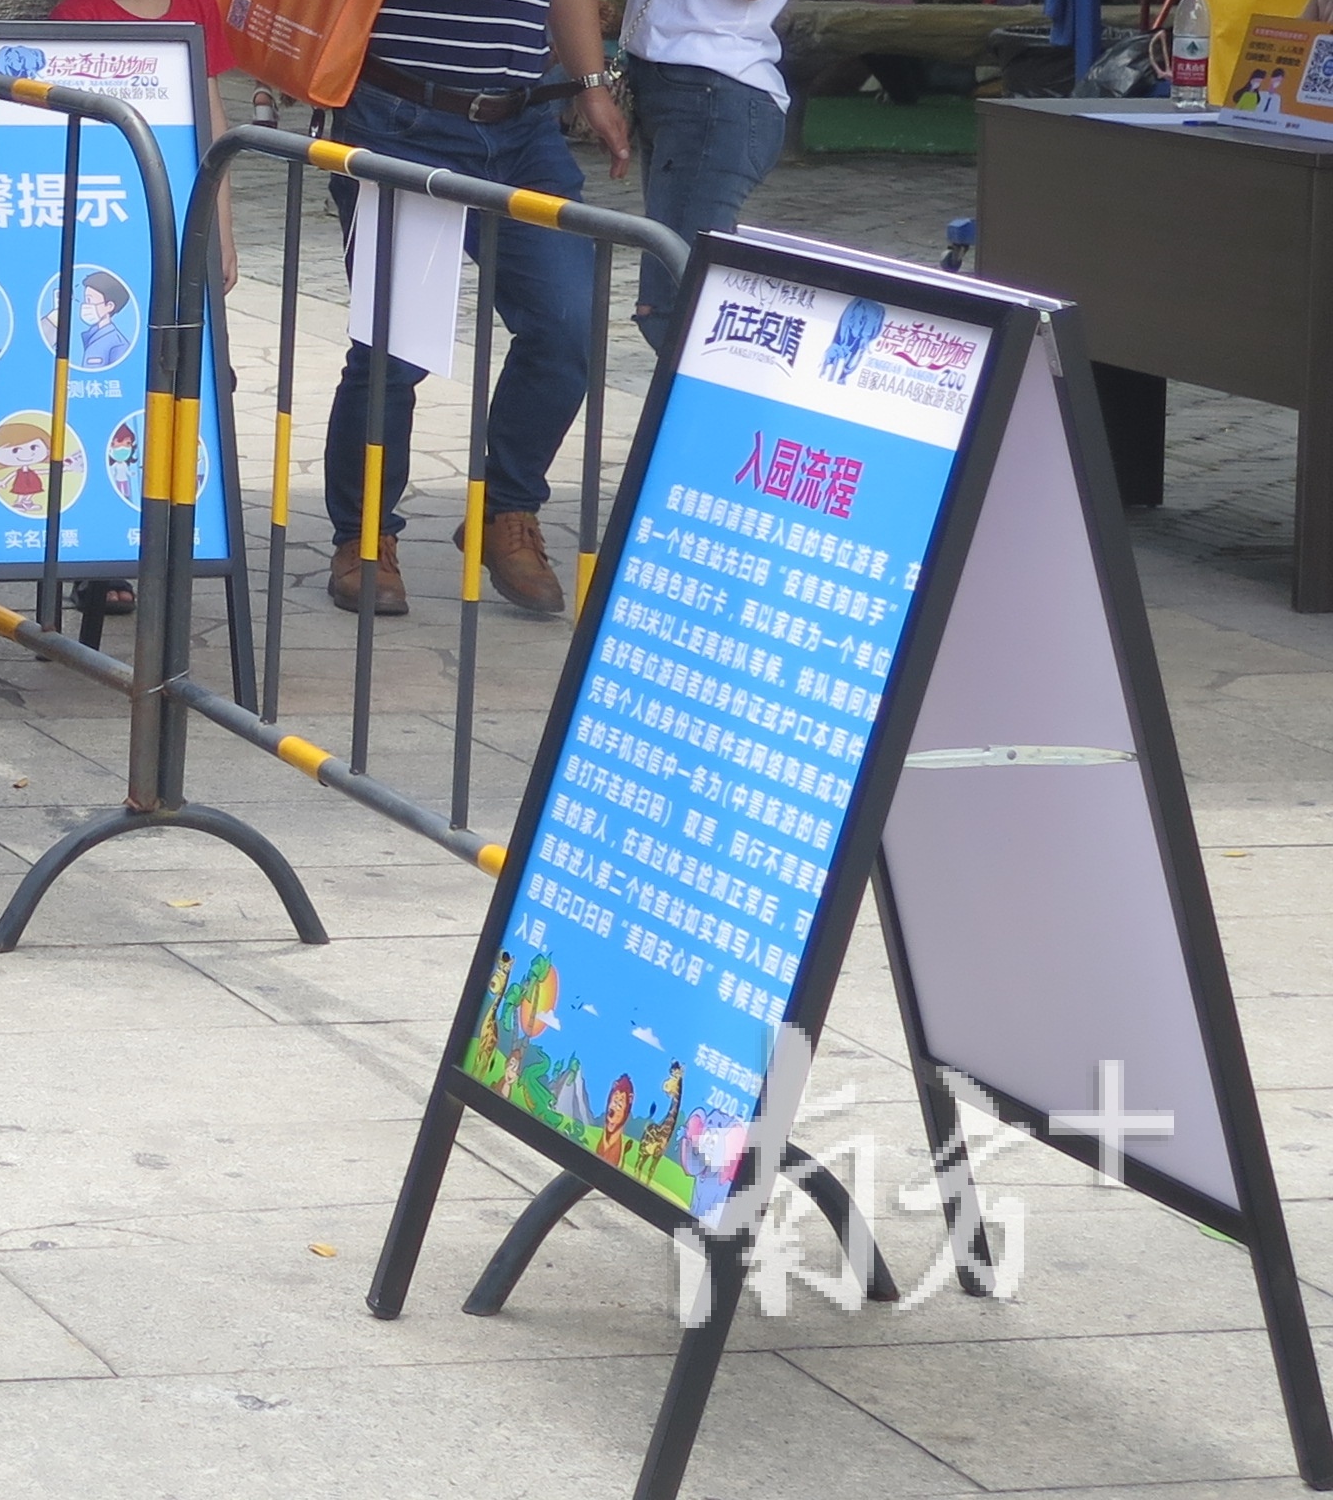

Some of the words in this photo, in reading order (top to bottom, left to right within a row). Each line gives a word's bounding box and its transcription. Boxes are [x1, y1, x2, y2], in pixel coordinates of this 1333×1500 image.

[47, 52, 159, 78] 东莞香市动物园
[704, 299, 807, 368] 抗击疫情
[734, 429, 865, 520] 入园流程
[4, 528, 80, 549] 实名票
